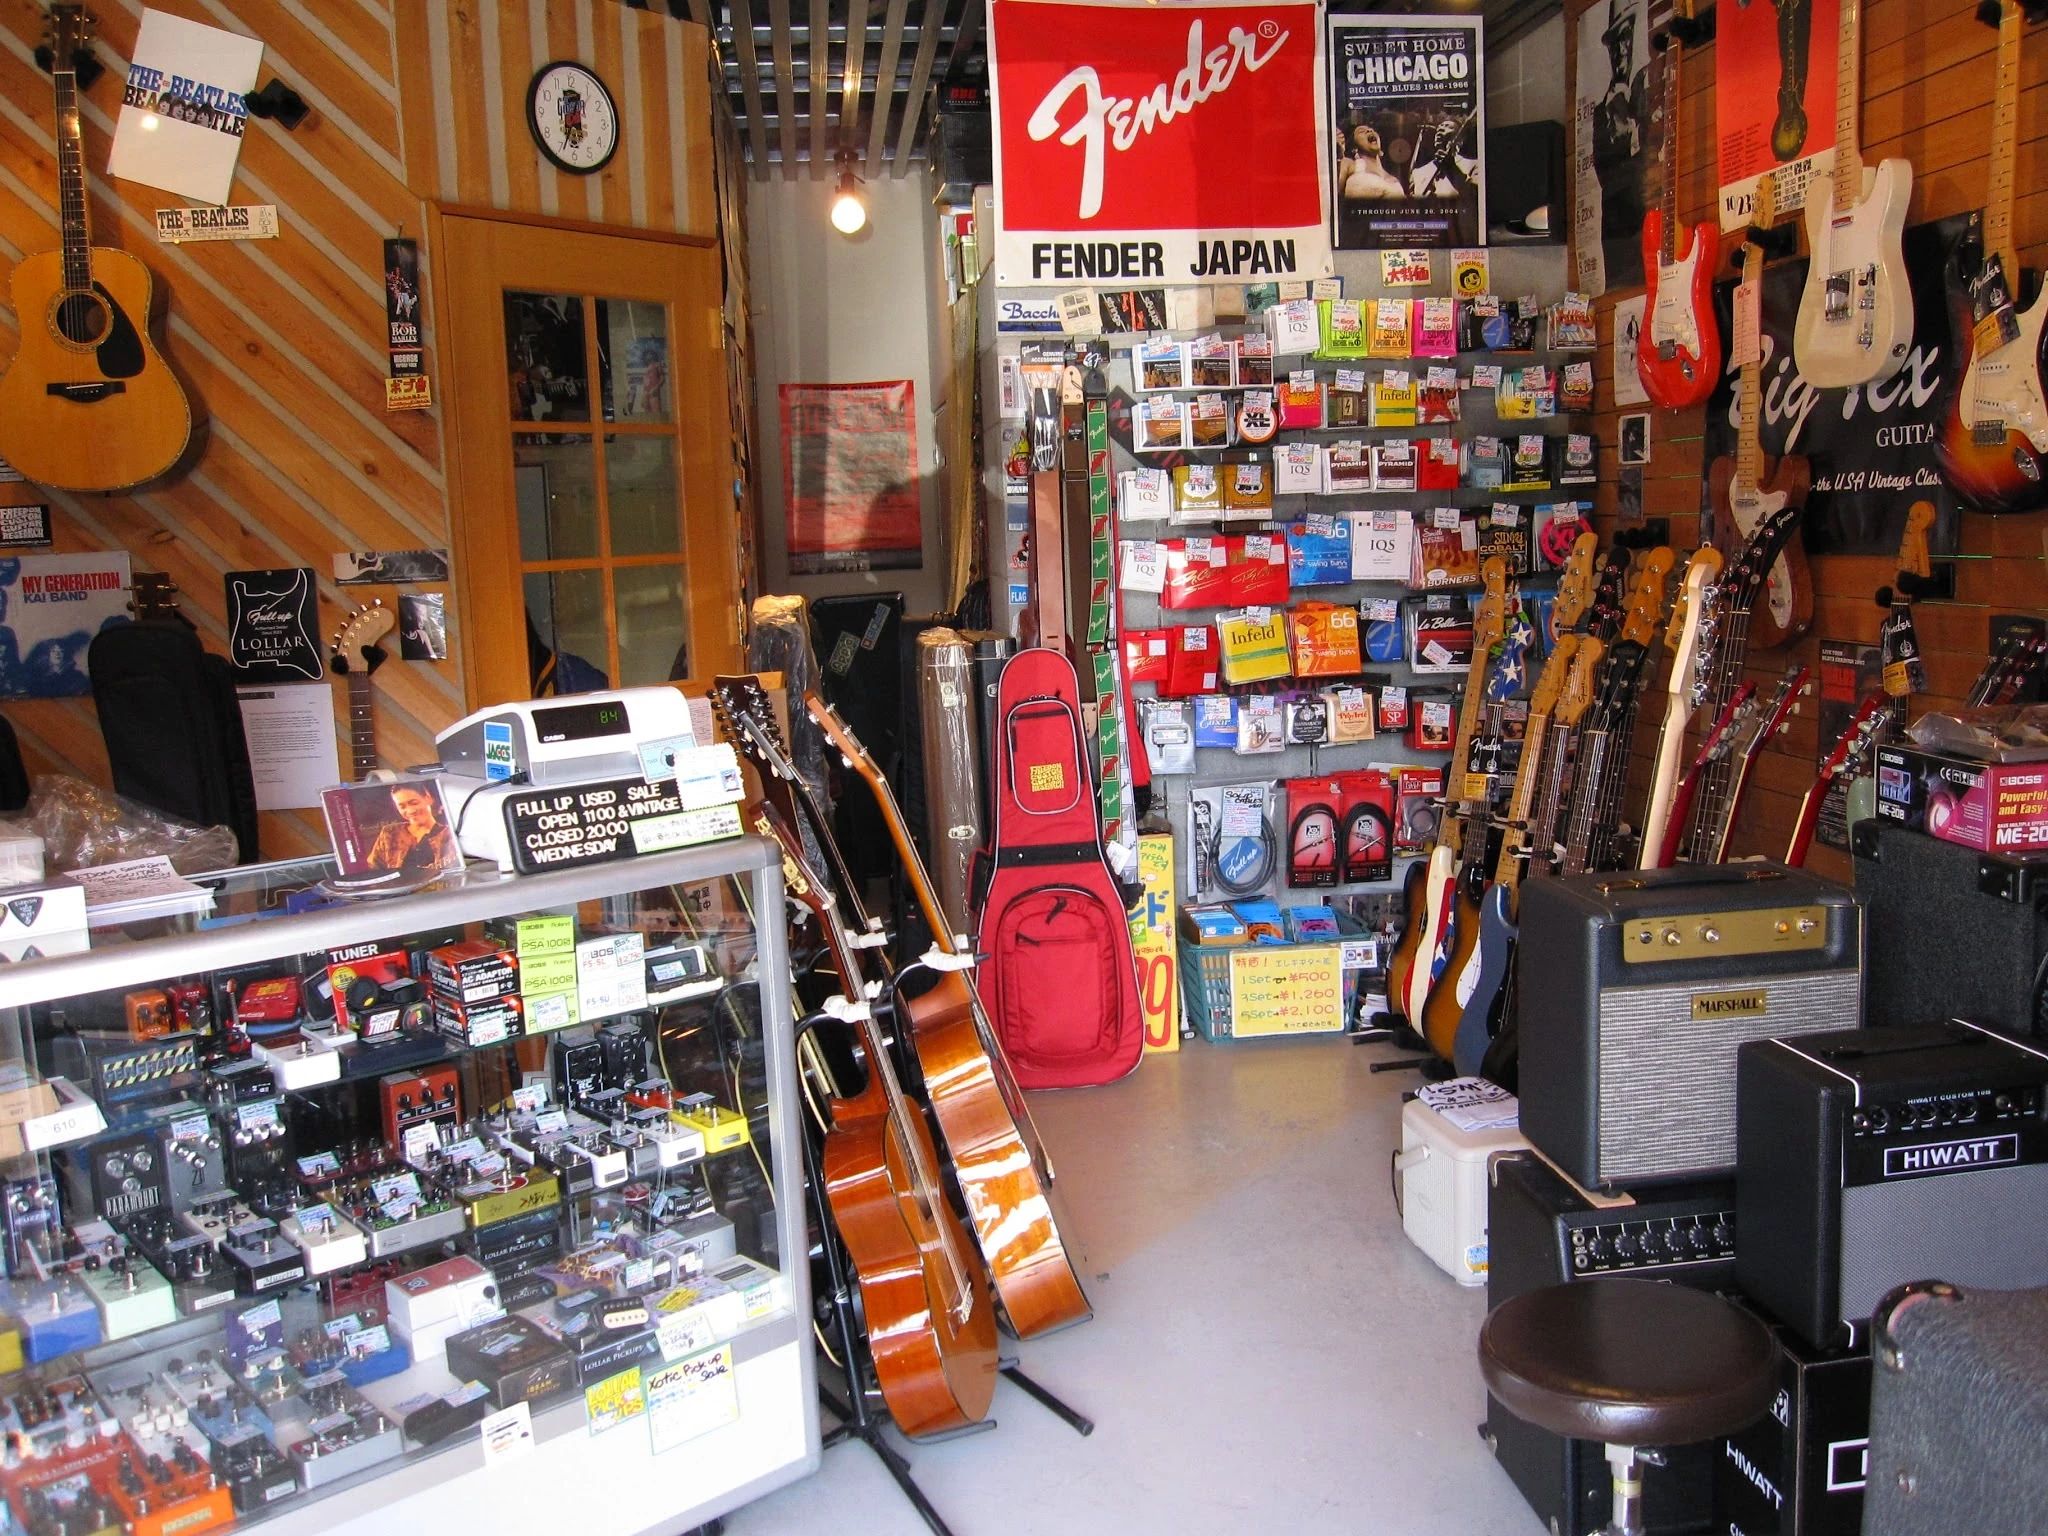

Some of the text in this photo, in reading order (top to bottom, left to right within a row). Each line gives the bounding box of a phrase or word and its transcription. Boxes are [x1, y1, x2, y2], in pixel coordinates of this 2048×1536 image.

[1344, 38, 1466, 56] SWEET HOME
[1347, 53, 1468, 85] CHICAGO
[130, 64, 249, 117] THE BEATLES
[1349, 86, 1365, 95] BIG
[1367, 85, 1389, 93] CITY
[1392, 84, 1421, 92] BLUES
[1027, 18, 1290, 219] Fender
[158, 208, 248, 229] THE BEATLES
[1032, 238, 1296, 279] FENDER JAPAN
[1388, 265, 1429, 283] 大特価
[1003, 302, 1060, 320] Bacch
[392, 326, 417, 336] BOB
[1288, 322, 1308, 333] IQS
[1380, 389, 1412, 401] Infeld
[1290, 465, 1310, 475] IQS
[1834, 472, 1865, 492] USA
[1868, 470, 1912, 491] Vintage
[2, 529, 44, 540] RESEARCH
[1370, 540, 1396, 553] IQS
[1136, 564, 1156, 576] IQS
[22, 572, 120, 593] MY GENERATION
[1427, 574, 1477, 587] BURNERS
[23, 591, 88, 604] KAI BAND
[1331, 613, 1355, 628] 66
[1418, 618, 1432, 630] La
[241, 636, 304, 651] LOLLAR
[1232, 626, 1275, 645] Infeld
[599, 711, 618, 724] 84
[1386, 712, 1401, 723] SP
[1470, 737, 1501, 753] Fender
[1032, 782, 1064, 792] RESEARCH
[2009, 775, 2042, 785] BOSS
[516, 784, 661, 817] FULL UP USED SALE
[538, 806, 616, 830] OPEN 1100
[1998, 805, 2017, 815] and
[526, 828, 584, 848] CLOSED
[587, 820, 629, 838] 2000
[532, 838, 618, 864] WEDNESDAY
[330, 943, 379, 963] TUNER
[462, 975, 475, 984] AC
[476, 967, 513, 982] ADAPTOR
[1289, 972, 1330, 982] ¥500
[1700, 997, 1759, 1013] MARSHALL
[368, 1017, 398, 1036] TIGHT
[103, 1051, 197, 1081] GENERATOR
[1907, 1091, 1974, 1104] HIWATT CUSTOM
[1904, 1141, 1999, 1169] HIWATT
[106, 1187, 159, 1217] PARAMOUNT
[484, 1248, 508, 1260] LOLLAR
[585, 1345, 643, 1371] LOLLAR PICKUPS
[649, 1371, 682, 1391] Xotic
[1727, 1440, 1783, 1510] HIWATT
